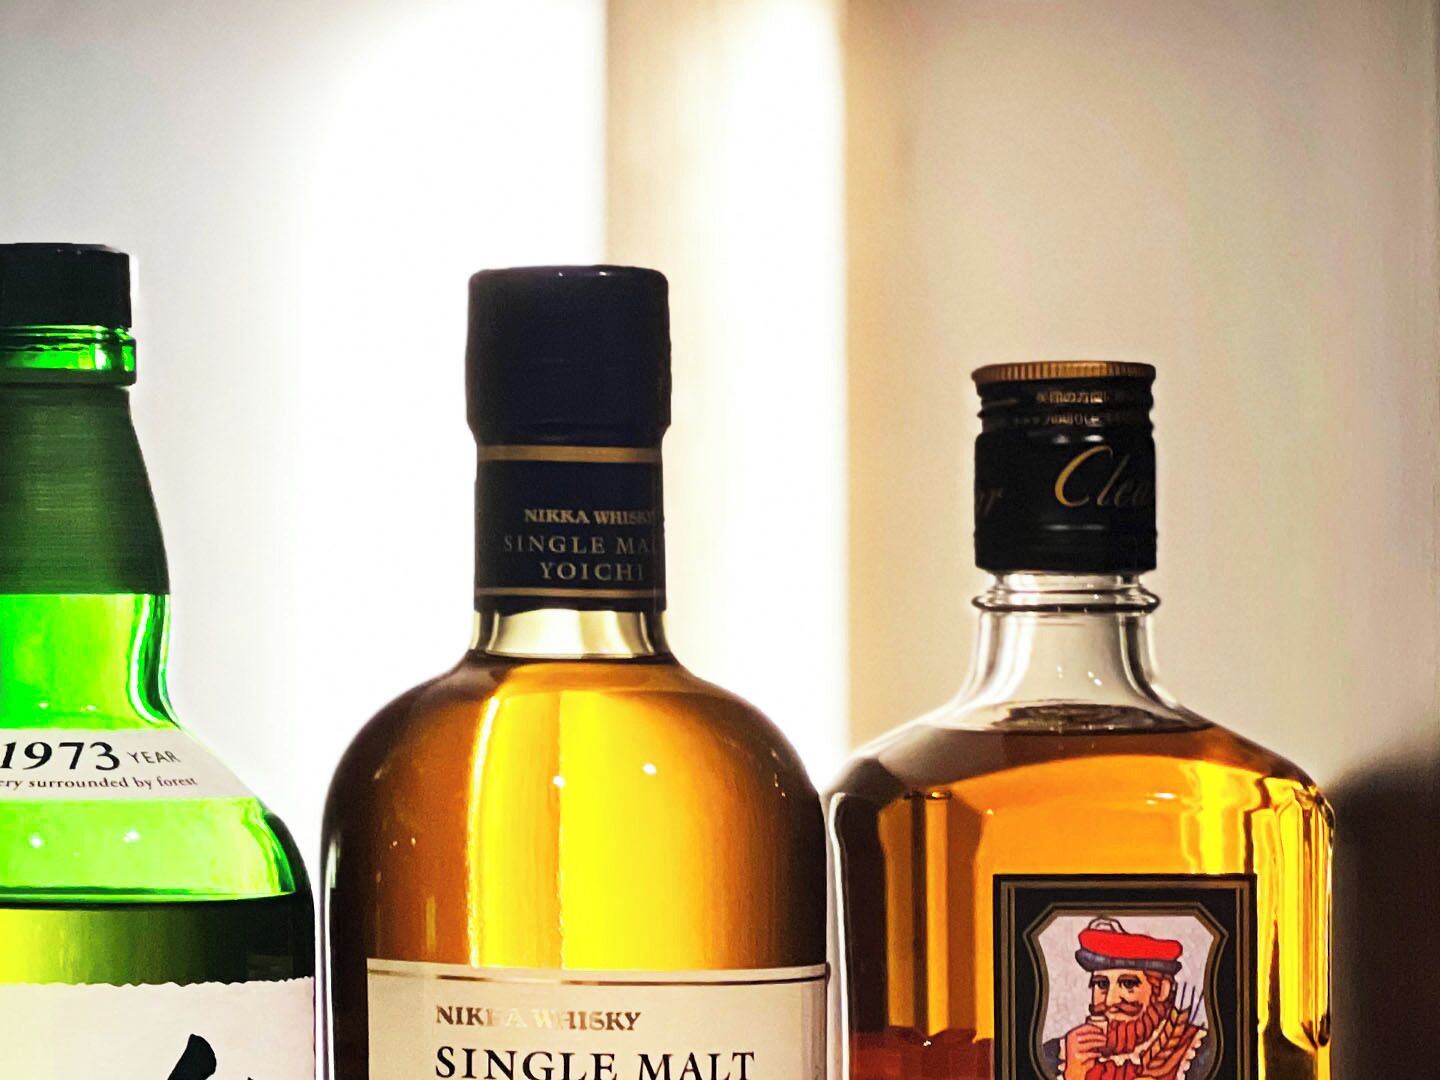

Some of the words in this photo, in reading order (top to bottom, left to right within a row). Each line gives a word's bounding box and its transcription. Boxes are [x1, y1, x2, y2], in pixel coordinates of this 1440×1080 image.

[524, 508, 590, 525] NIKKA
[504, 536, 605, 554] SINGLE
[616, 537, 656, 555] MA
[540, 561, 643, 582] YOICHI
[127, 750, 182, 765] YEAR
[28, 775, 129, 789] surrounded
[135, 776, 152, 790] by
[156, 775, 199, 788] forest
[530, 1008, 641, 1031] WHISKY
